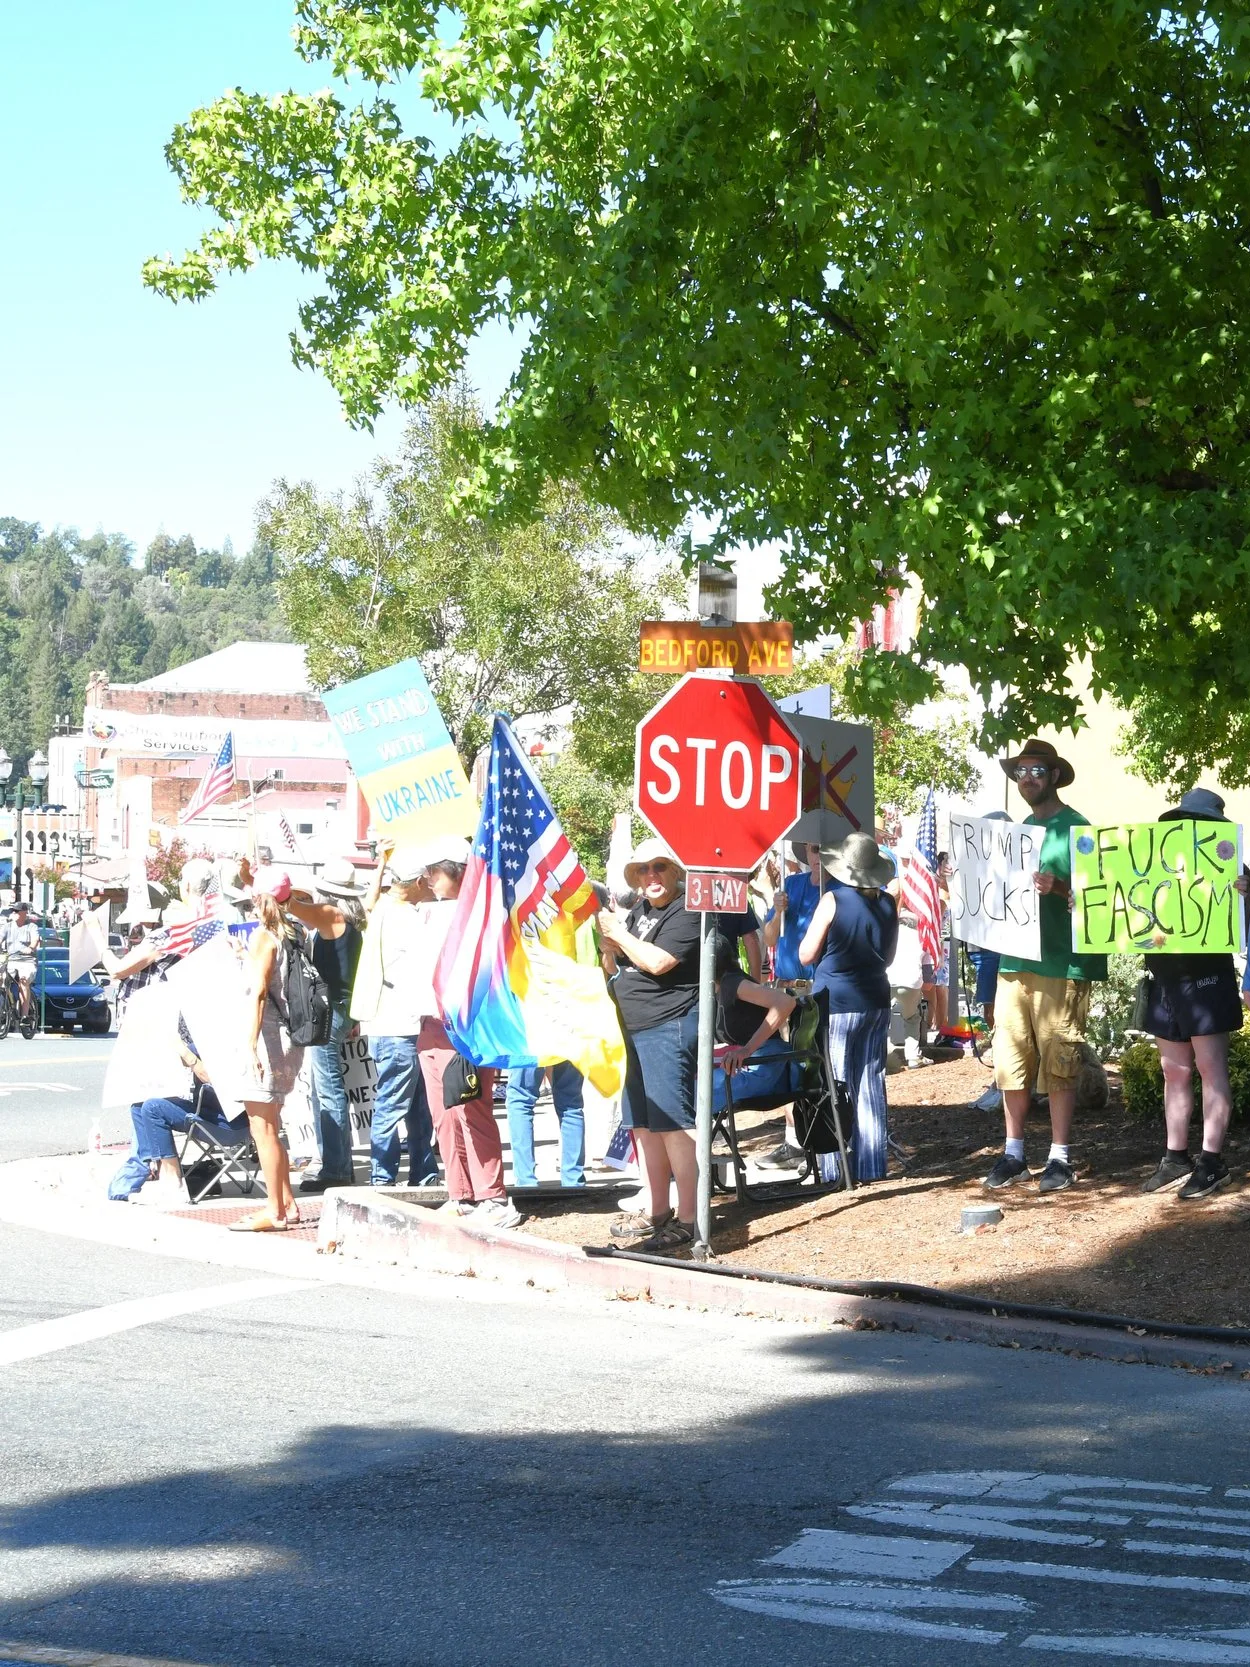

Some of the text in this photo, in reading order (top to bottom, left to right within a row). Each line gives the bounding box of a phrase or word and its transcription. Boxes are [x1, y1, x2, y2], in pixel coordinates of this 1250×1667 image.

[640, 639, 790, 668] BEDFORD AVE
[333, 688, 430, 736] WE STAND
[143, 738, 208, 752] Services
[377, 729, 428, 762] WITH
[376, 769, 463, 823] UKRAINE
[646, 734, 793, 811] STOP
[950, 820, 1033, 870] TRUMP
[1097, 820, 1225, 880] FUCK
[953, 868, 1036, 926] SUCKS!
[1082, 876, 1235, 947] FASCISM
